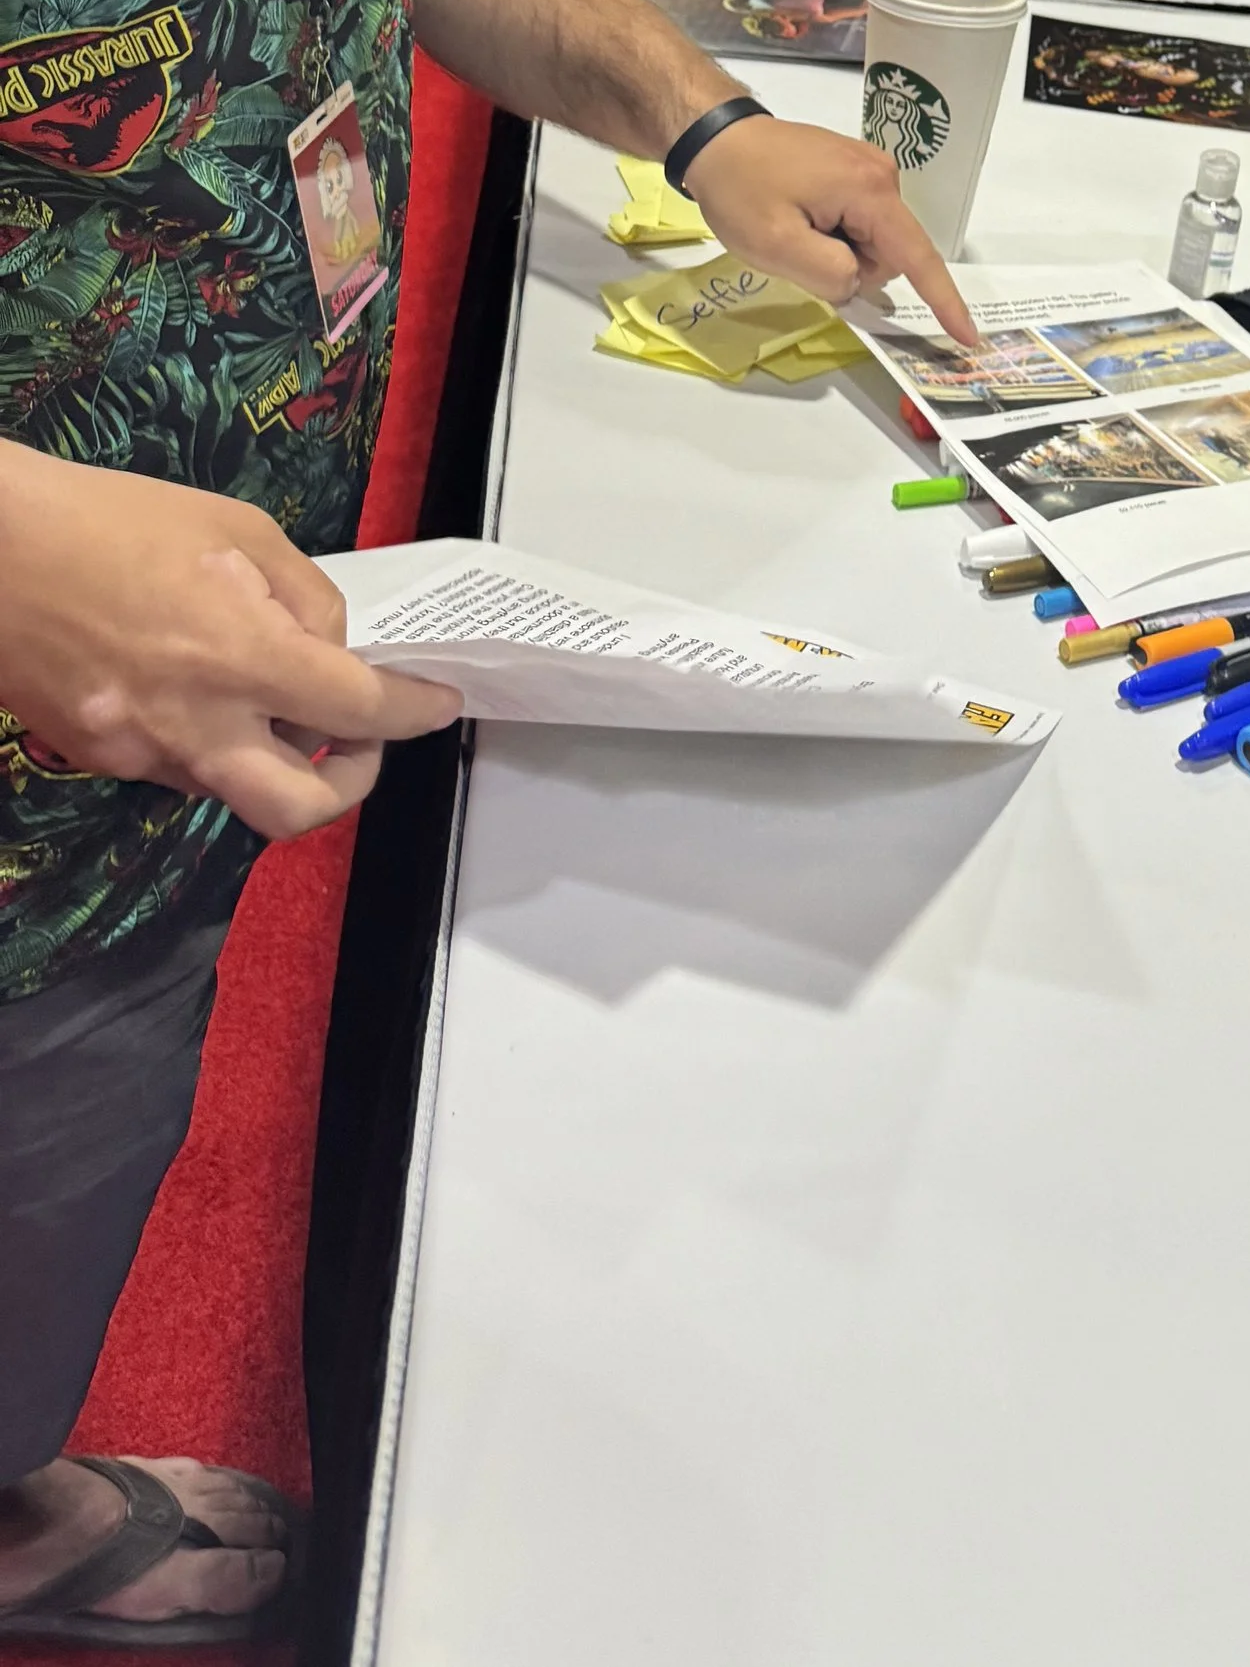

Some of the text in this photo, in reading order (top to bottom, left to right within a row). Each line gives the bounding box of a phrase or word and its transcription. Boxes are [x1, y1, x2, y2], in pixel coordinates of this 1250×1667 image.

[29, 14, 180, 98] JURASSIC
[657, 270, 769, 332] Selfie
[368, 610, 404, 630] much.
[405, 620, 437, 640] facts
